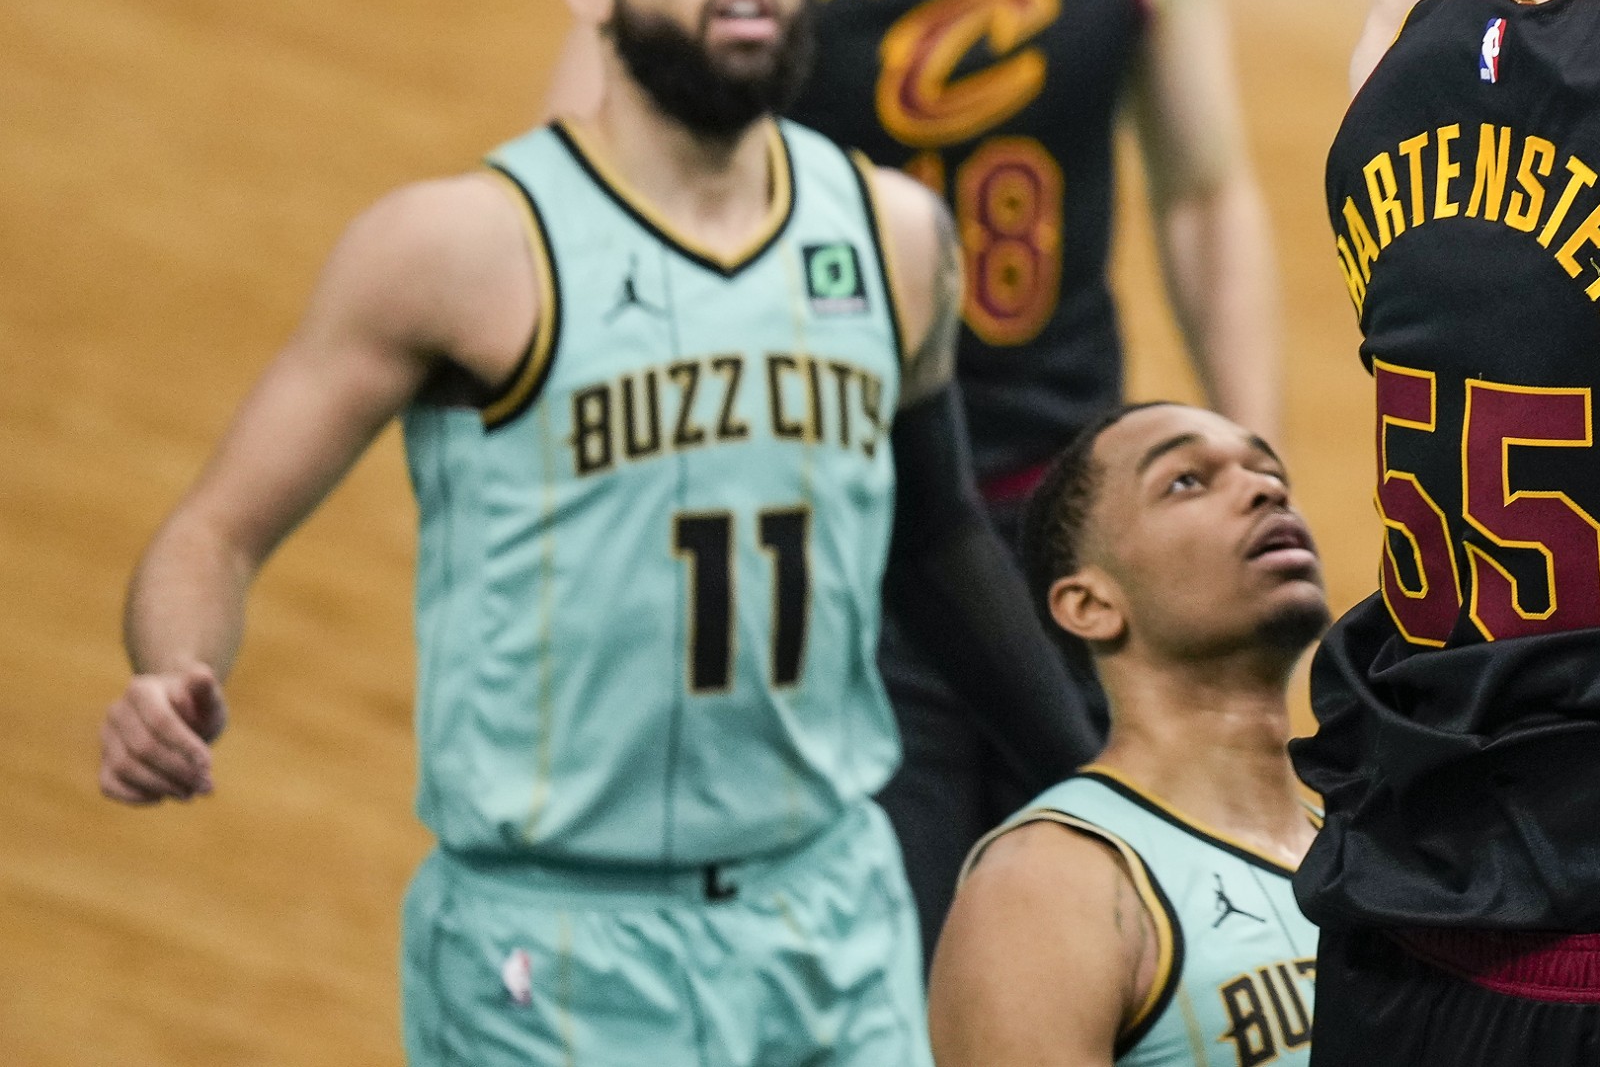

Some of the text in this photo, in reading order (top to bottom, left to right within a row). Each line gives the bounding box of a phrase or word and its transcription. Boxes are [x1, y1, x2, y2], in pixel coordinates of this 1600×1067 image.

[903, 137, 1064, 347] 8
[568, 353, 891, 477] BUZZ CITY
[672, 505, 812, 695] 11
